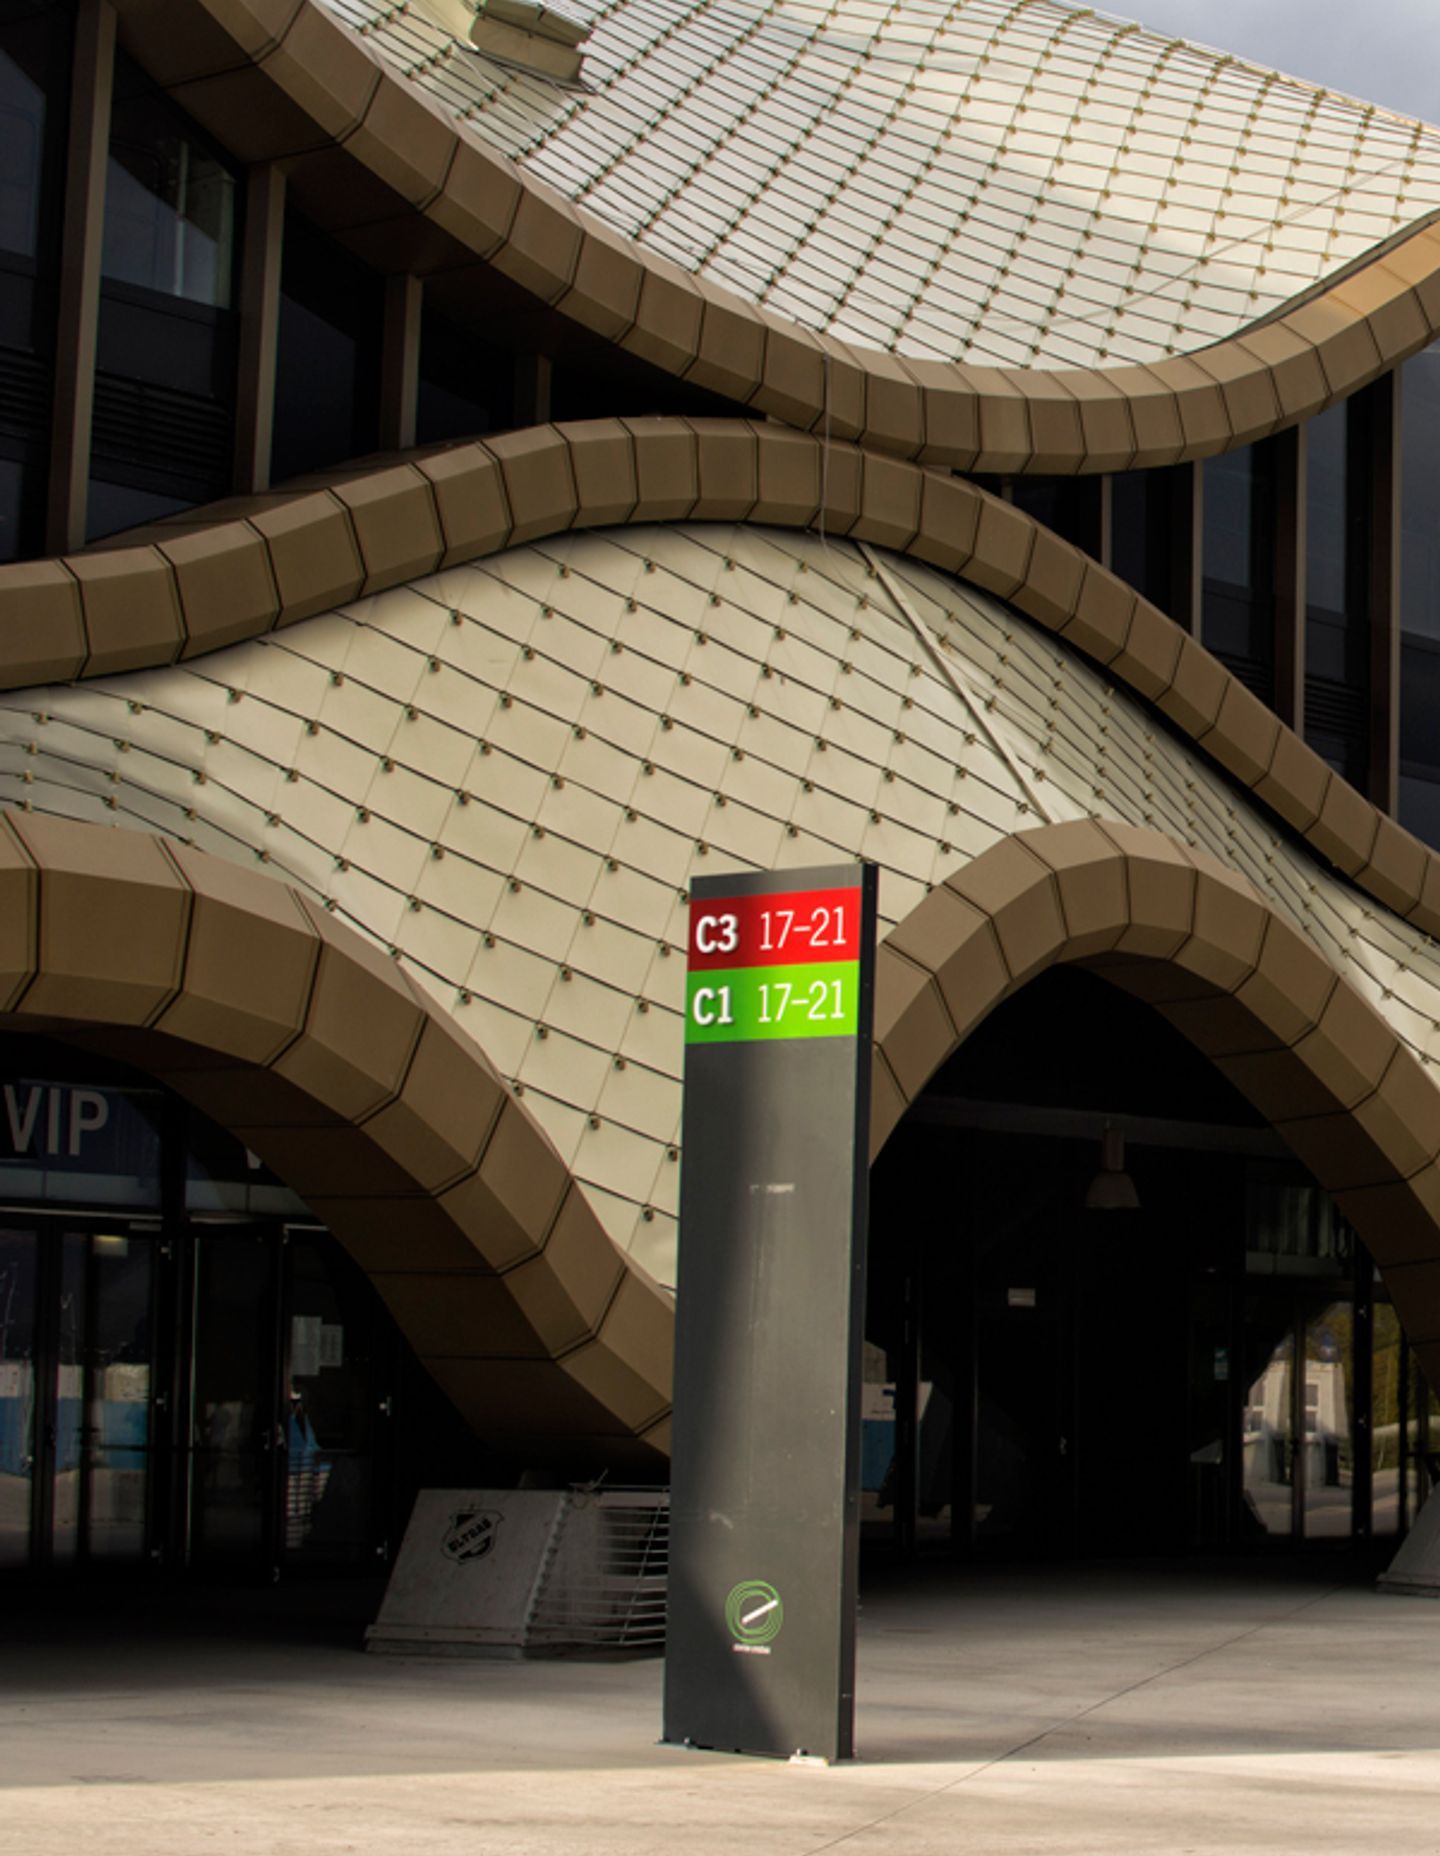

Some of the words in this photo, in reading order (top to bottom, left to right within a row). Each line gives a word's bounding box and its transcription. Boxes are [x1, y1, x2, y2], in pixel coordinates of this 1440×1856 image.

[695, 914, 738, 953] C3
[760, 906, 847, 950] 17-21
[693, 986, 733, 1025] C1
[758, 979, 846, 1023] 17-21
[3, 1084, 110, 1156] VIP
